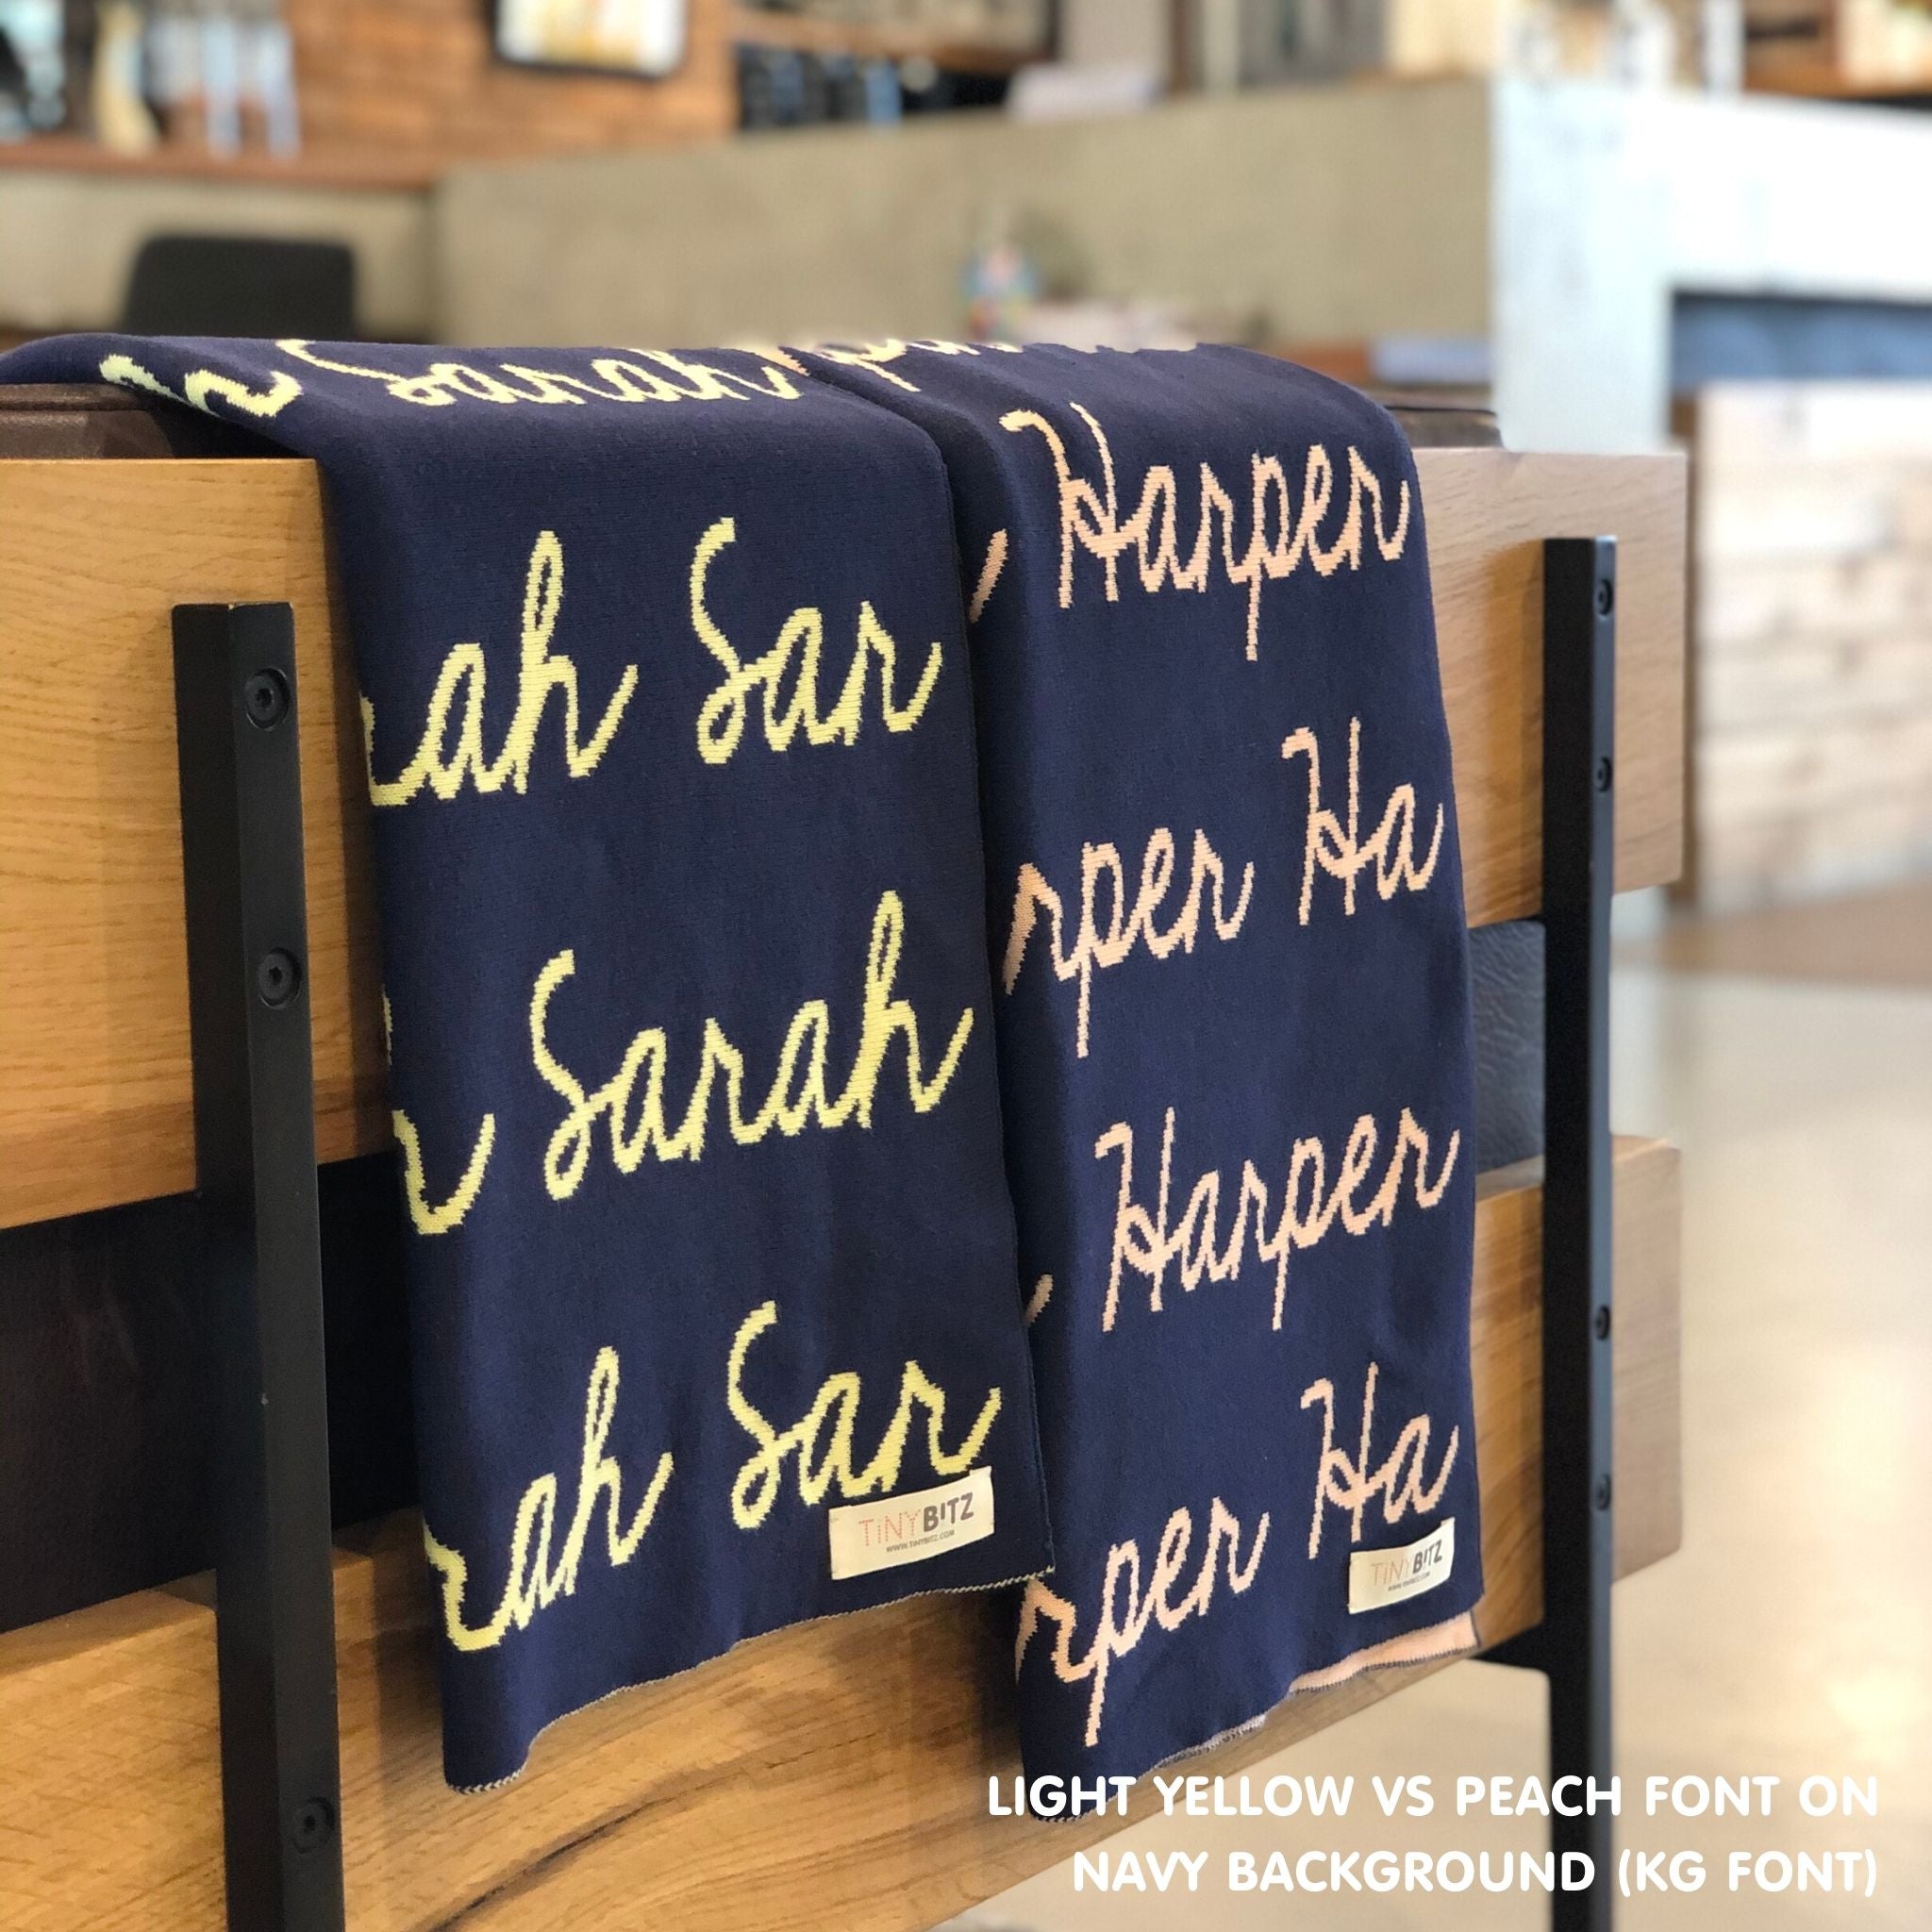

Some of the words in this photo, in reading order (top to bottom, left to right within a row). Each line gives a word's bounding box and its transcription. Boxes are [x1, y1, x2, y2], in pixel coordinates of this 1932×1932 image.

[690, 518, 941, 763] Sar
[999, 403, 1410, 661] Harper
[1282, 717, 1443, 925] Ha
[529, 891, 974, 1200] Sarah
[1095, 1108, 1460, 1331] Harper
[727, 1301, 1001, 1529] Sar
[1301, 1362, 1458, 1559] Ha
